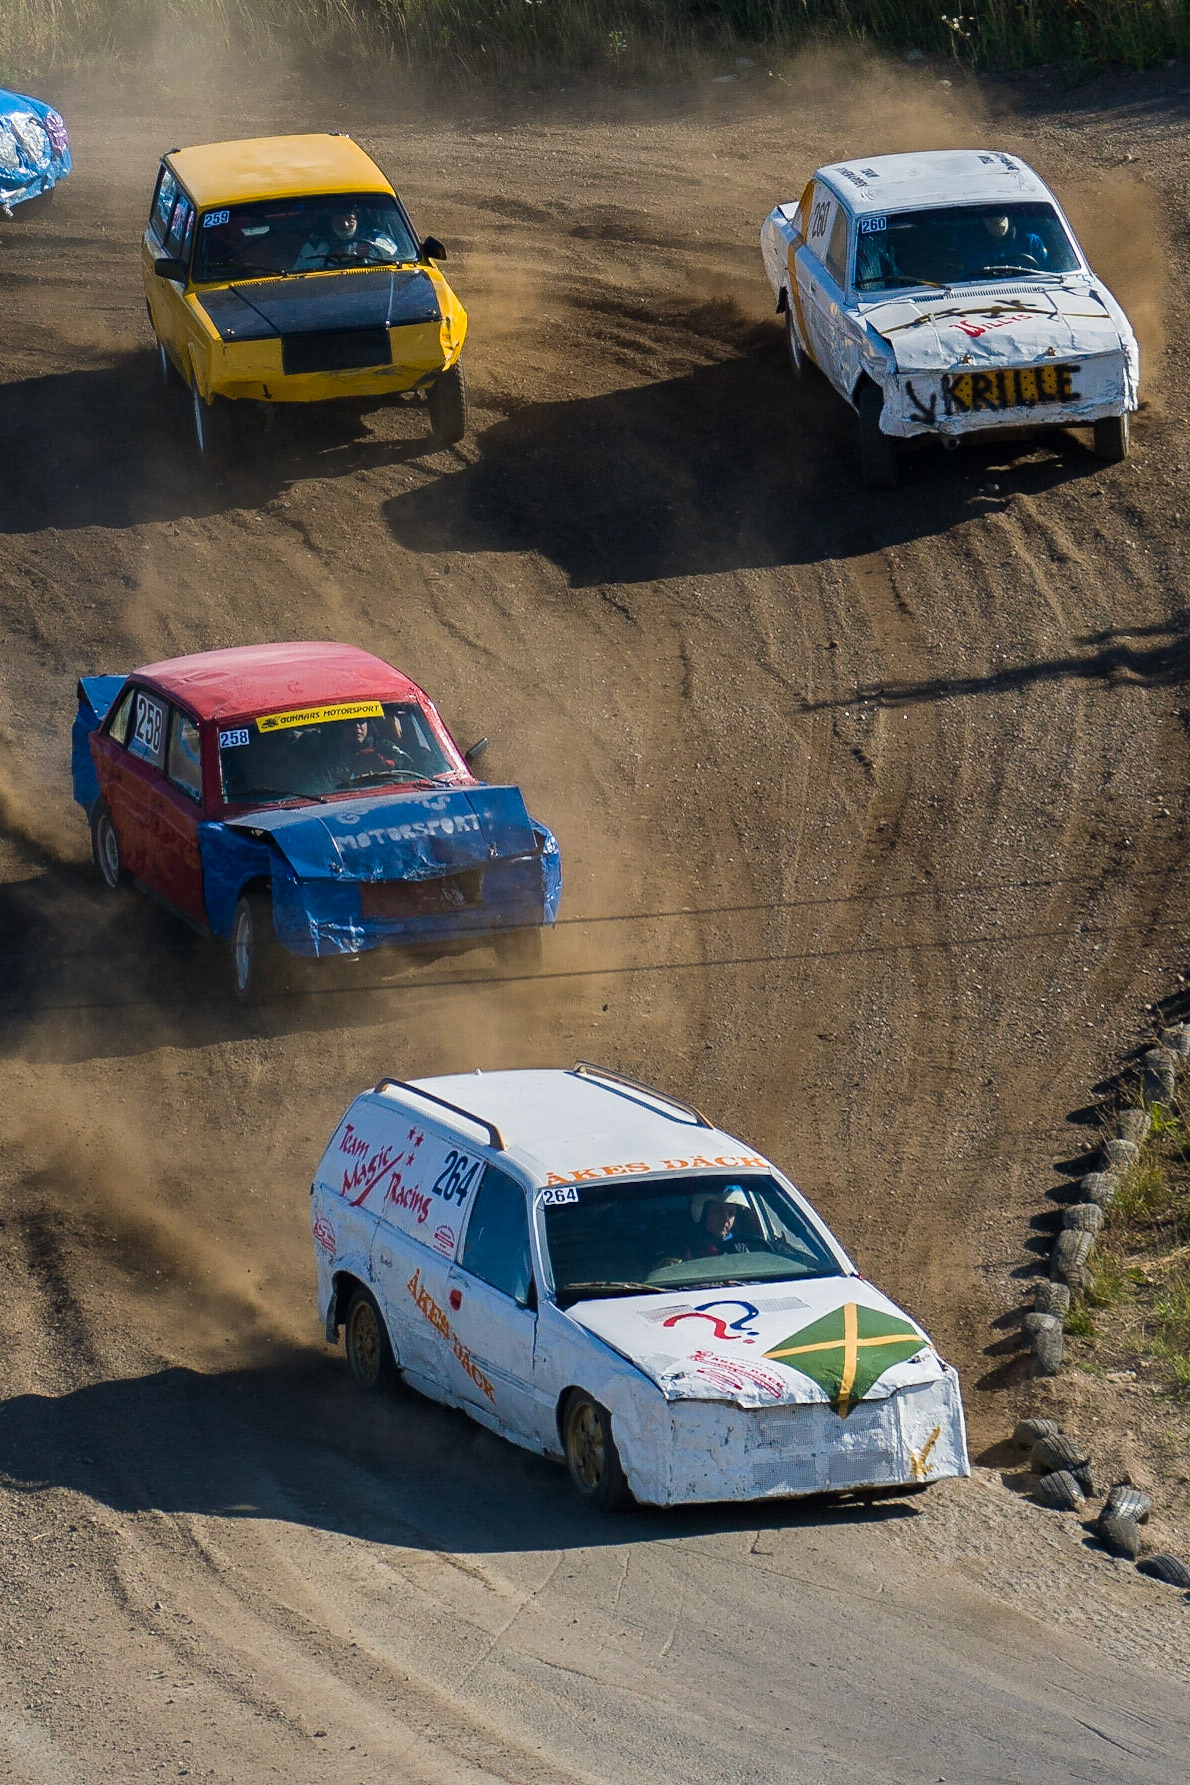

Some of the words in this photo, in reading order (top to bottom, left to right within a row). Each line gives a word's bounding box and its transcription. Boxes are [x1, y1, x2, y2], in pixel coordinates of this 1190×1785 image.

[204, 211, 229, 226] 259
[812, 201, 831, 239] 260
[862, 218, 886, 232] 260
[137, 697, 162, 751] 258
[280, 711, 320, 724] GUNNARS
[323, 704, 380, 717] MOTORSPORT
[220, 730, 248, 748] 258
[335, 813, 481, 851] MOTORSPORT
[340, 1124, 370, 1160] Team
[432, 1150, 481, 1207] 264
[546, 1161, 651, 1187] ÅKES
[658, 1155, 770, 1170] DÄCK
[384, 1171, 433, 1224] Racing
[544, 1188, 577, 1204] 264
